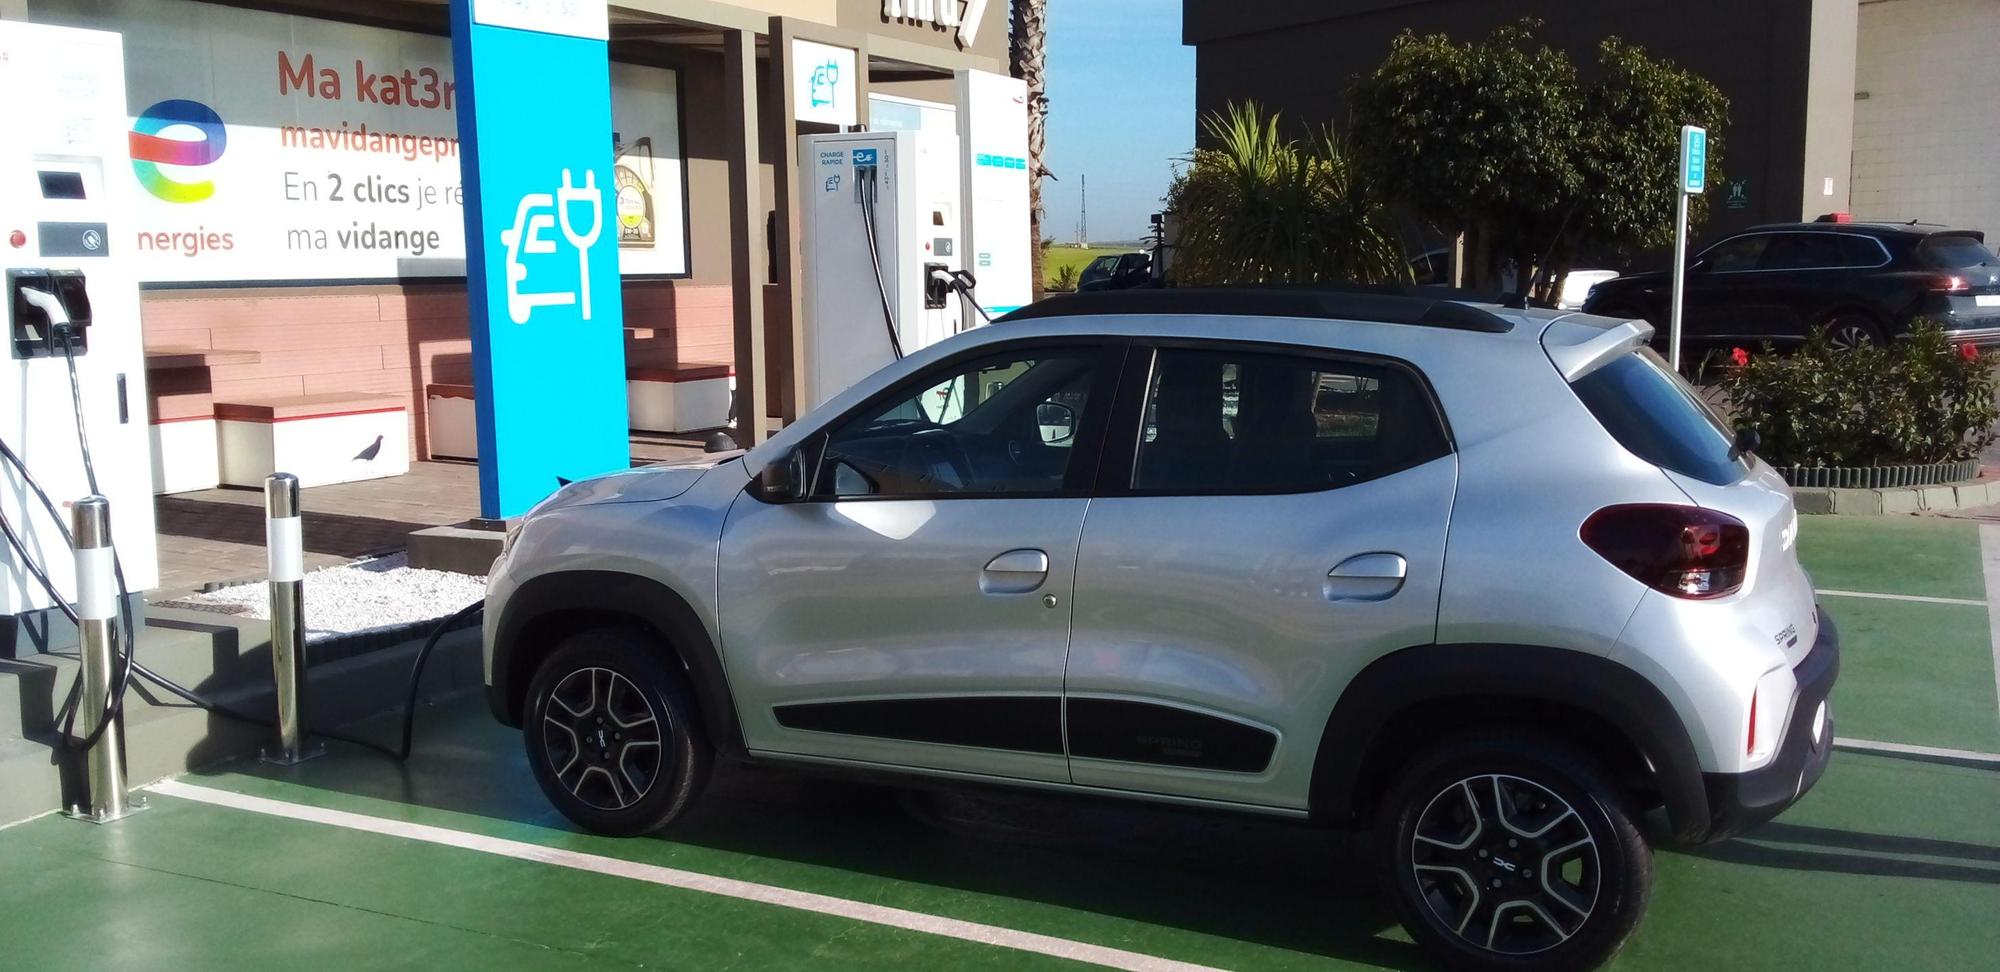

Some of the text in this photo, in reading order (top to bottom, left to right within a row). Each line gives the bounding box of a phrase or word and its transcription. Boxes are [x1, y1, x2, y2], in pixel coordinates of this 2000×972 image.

[277, 50, 341, 100] Ma
[284, 171, 318, 201] En
[327, 173, 345, 202] 2
[353, 175, 410, 204] clics
[415, 177, 437, 211] je
[287, 221, 441, 256] ma vidange
